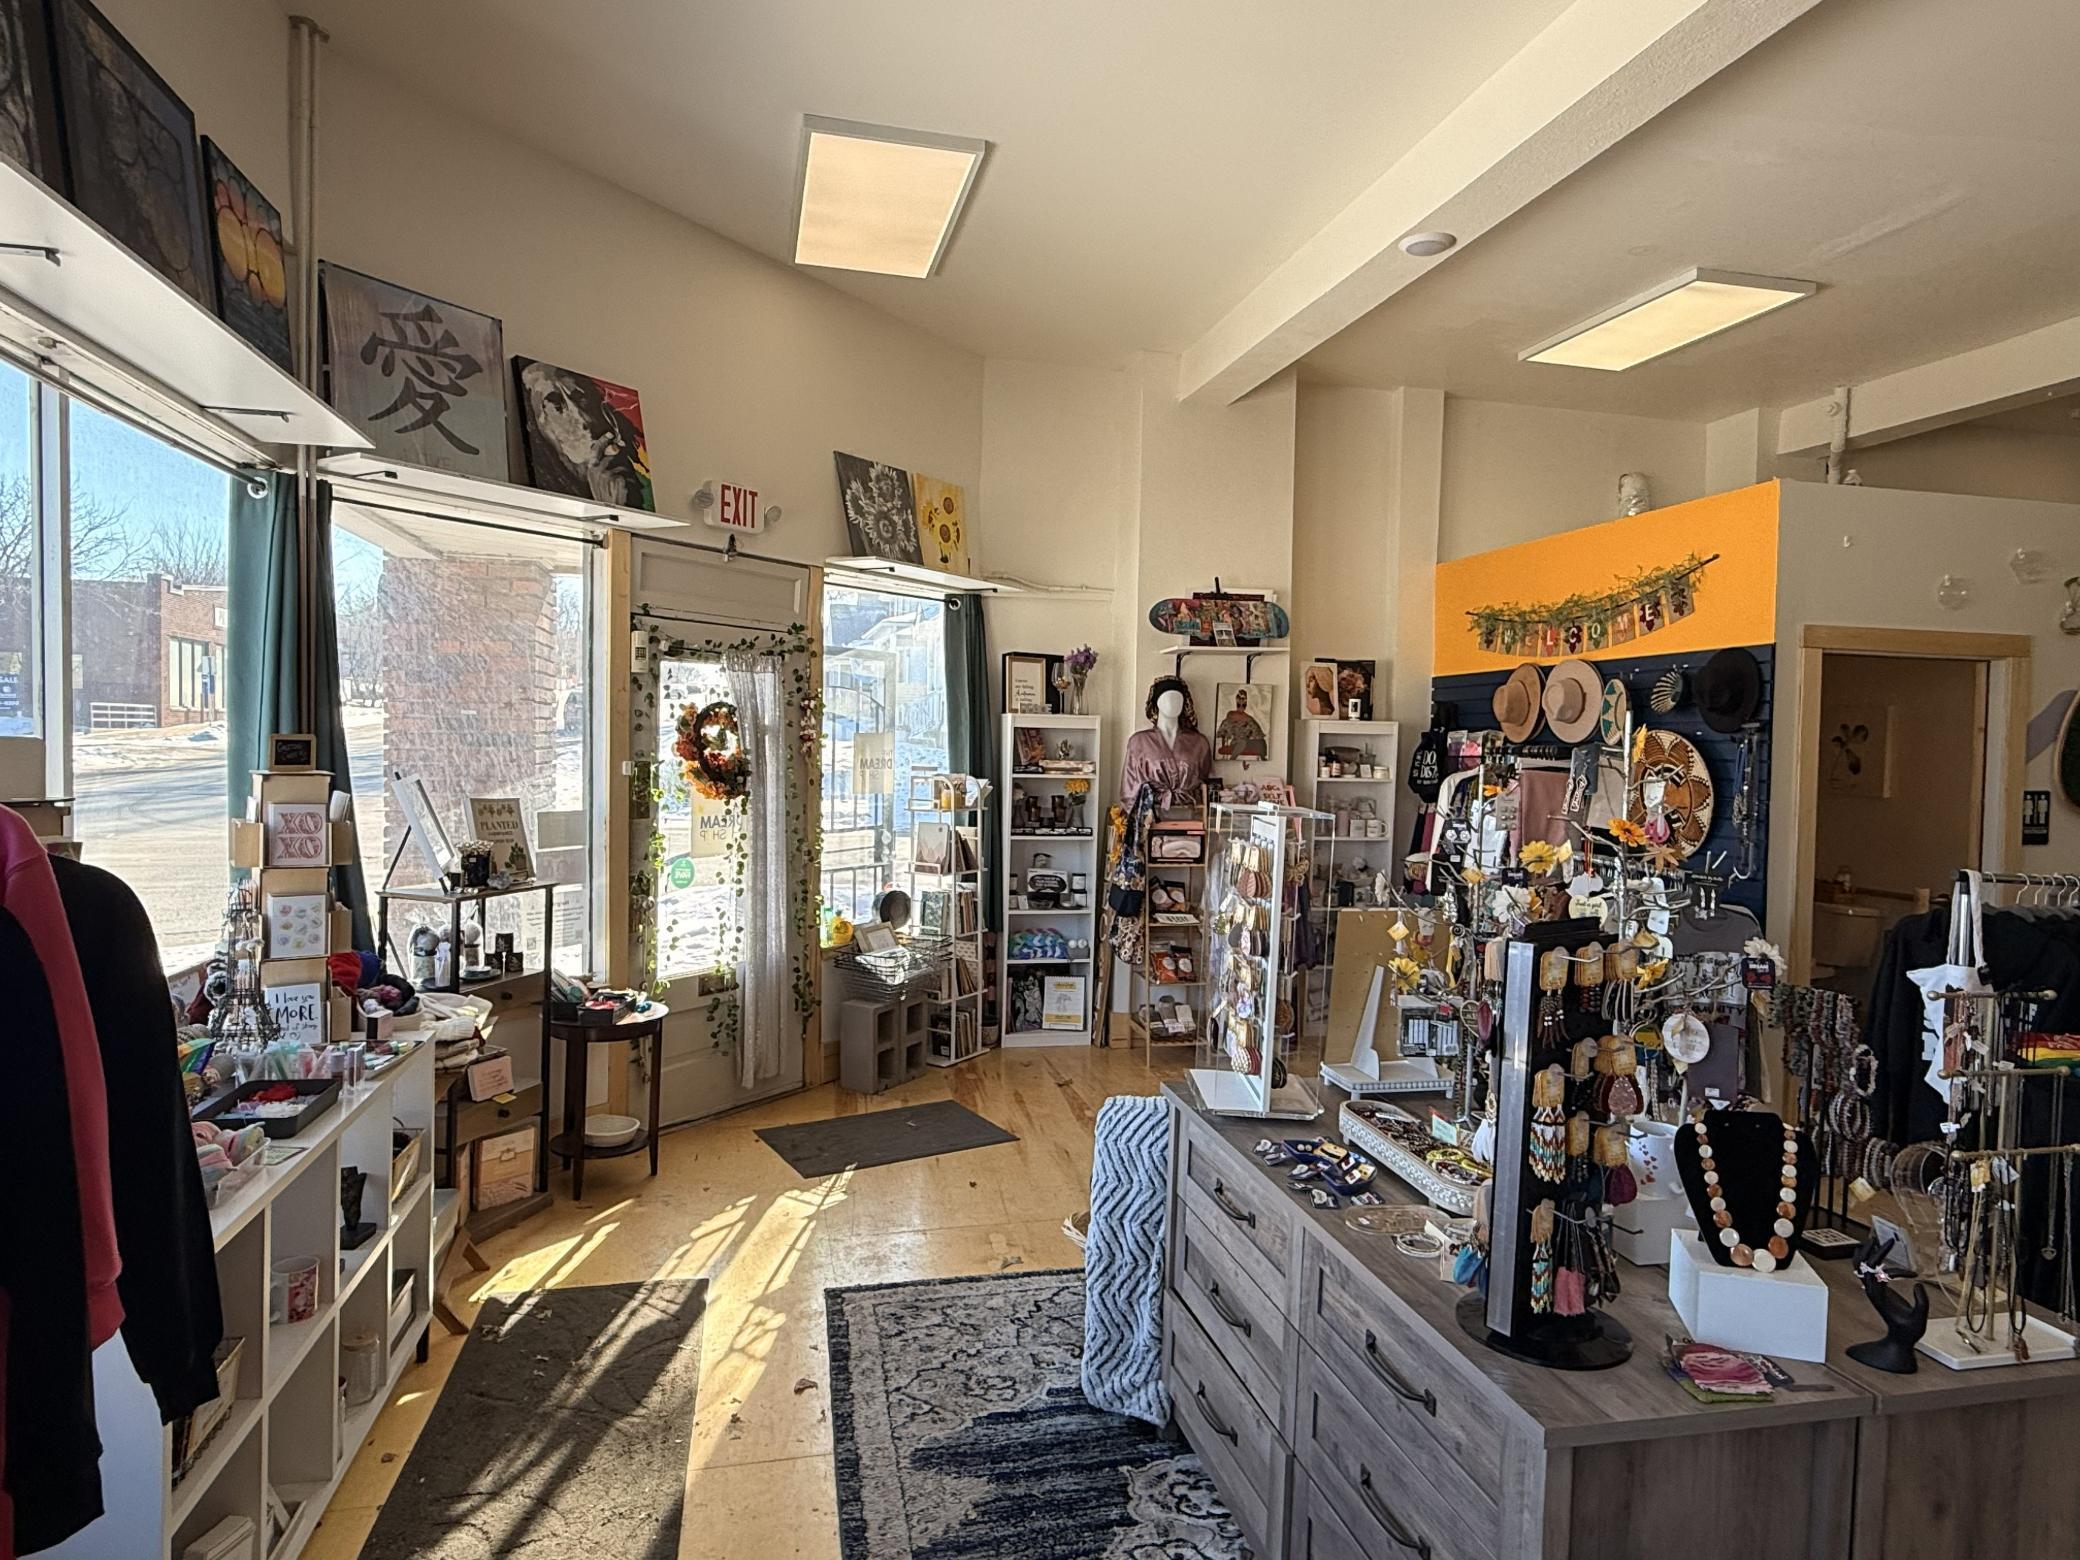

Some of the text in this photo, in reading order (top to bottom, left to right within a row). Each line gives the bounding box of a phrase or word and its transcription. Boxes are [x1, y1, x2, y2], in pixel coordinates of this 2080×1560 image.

[360, 304, 484, 455] 愛
[720, 483, 758, 529] EXIT
[278, 812, 322, 835] XO
[480, 821, 519, 831] PLANTED
[277, 836, 322, 859] XO
